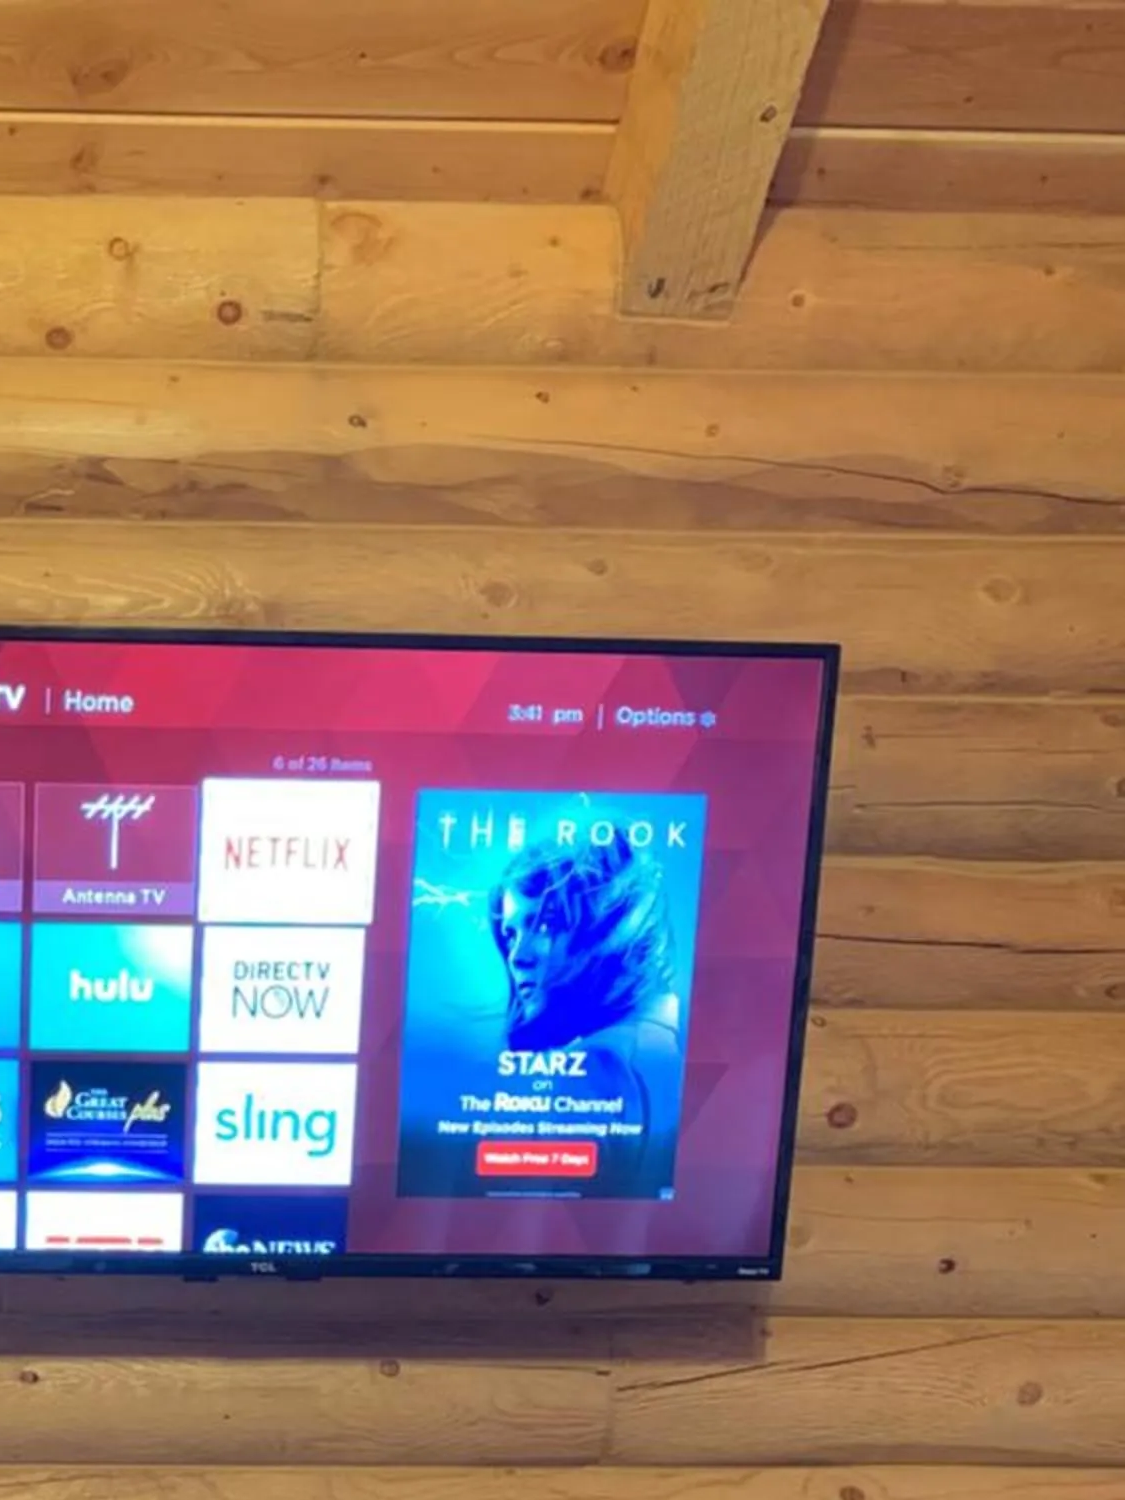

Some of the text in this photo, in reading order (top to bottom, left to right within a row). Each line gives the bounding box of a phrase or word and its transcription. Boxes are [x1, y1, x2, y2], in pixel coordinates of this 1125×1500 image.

[63, 690, 134, 713] Home
[552, 708, 584, 726] pm
[616, 706, 697, 728] Options
[438, 807, 687, 852] THE ROOK
[224, 835, 351, 872] NETFLIX
[62, 887, 166, 906] Antenna TV
[70, 969, 153, 1001] hulu
[231, 984, 331, 1020] NOW
[497, 1052, 587, 1076] STARZ
[531, 1079, 554, 1091] on
[459, 1095, 491, 1113] The
[554, 1096, 623, 1113] Channel
[215, 1093, 338, 1157] sling
[438, 1120, 642, 1138] New Episodes Streaming Now
[250, 1261, 277, 1272] TCL
